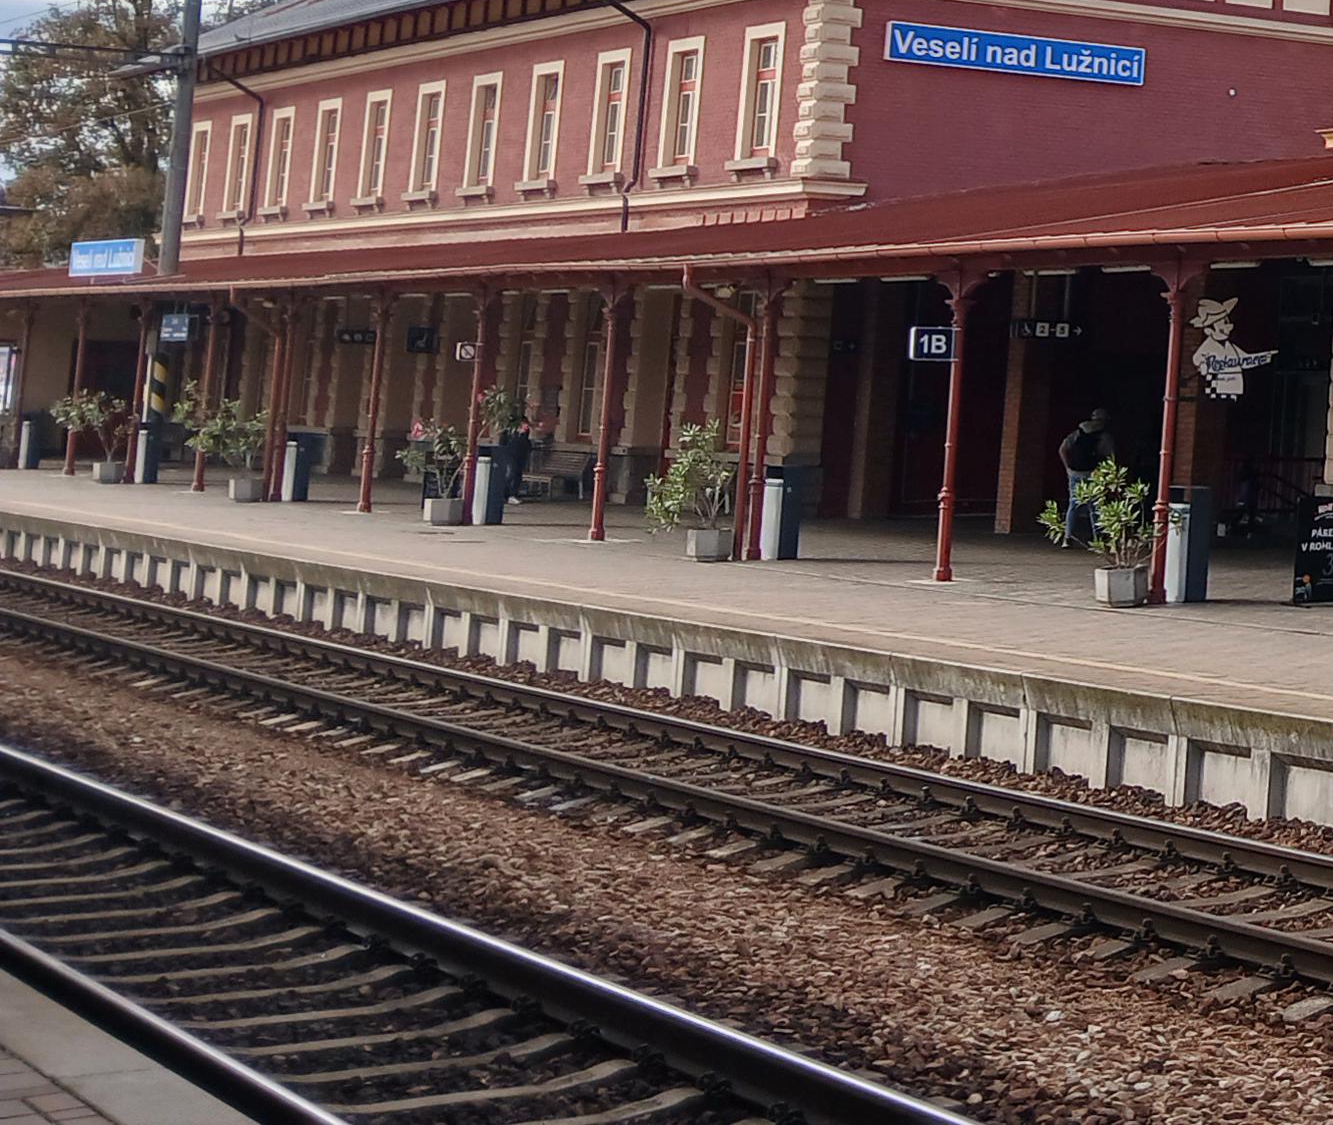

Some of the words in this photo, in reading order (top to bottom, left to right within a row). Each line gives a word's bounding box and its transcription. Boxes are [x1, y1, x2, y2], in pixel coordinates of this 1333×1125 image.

[893, 28, 980, 62] Veselí
[985, 44, 1037, 68] nad
[1044, 45, 1140, 78] Lužnicí
[919, 334, 948, 355] 1B
